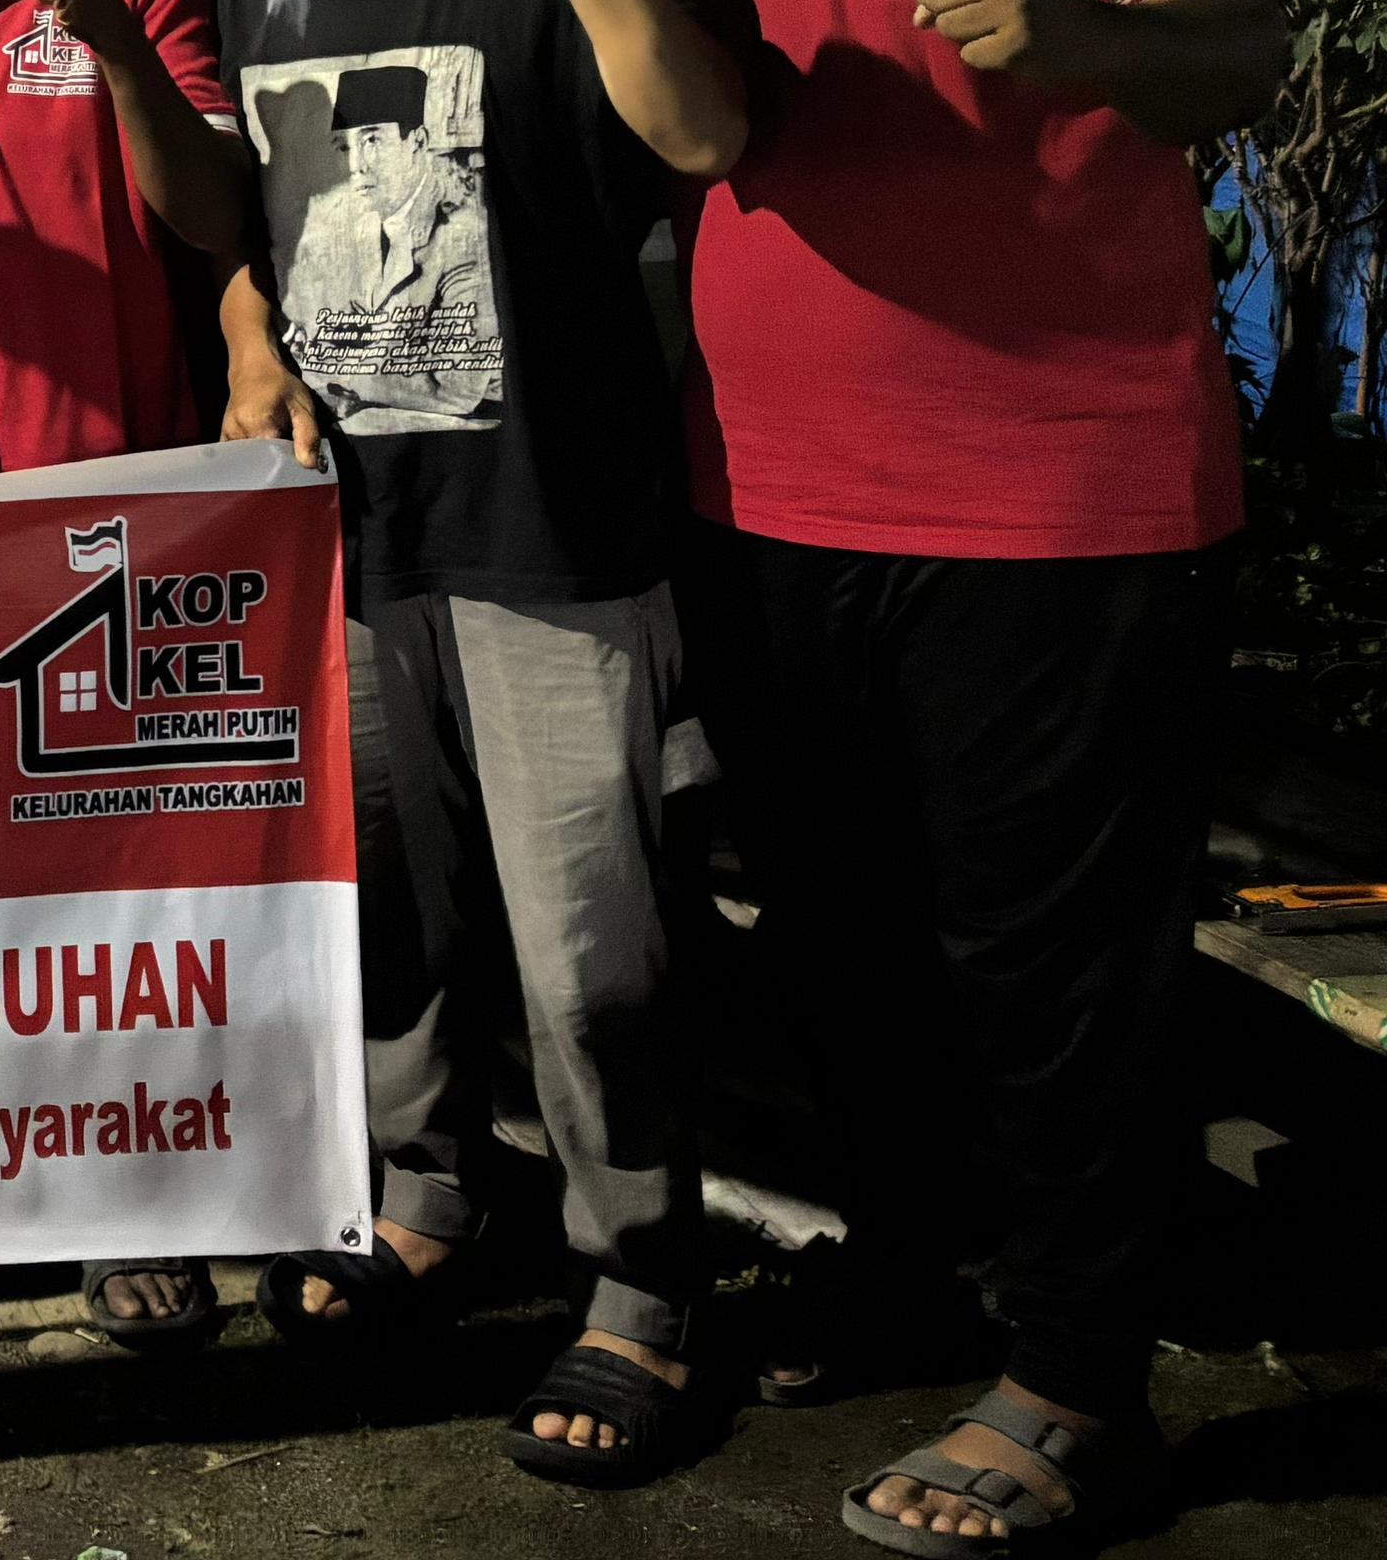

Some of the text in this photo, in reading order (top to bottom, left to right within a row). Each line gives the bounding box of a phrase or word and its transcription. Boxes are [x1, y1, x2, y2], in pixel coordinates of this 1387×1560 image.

[50, 43, 90, 62] KEL
[391, 306, 426, 324] lebih
[430, 301, 477, 320] mudah
[390, 342, 429, 358] akan
[433, 338, 469, 355] lebih
[382, 357, 454, 376] bangsamu
[136, 570, 267, 631] KOP
[136, 640, 264, 700] KEL
[136, 706, 299, 743] MERAH PUTIH
[11, 778, 305, 822] KELURAHAN TANGKAHAN
